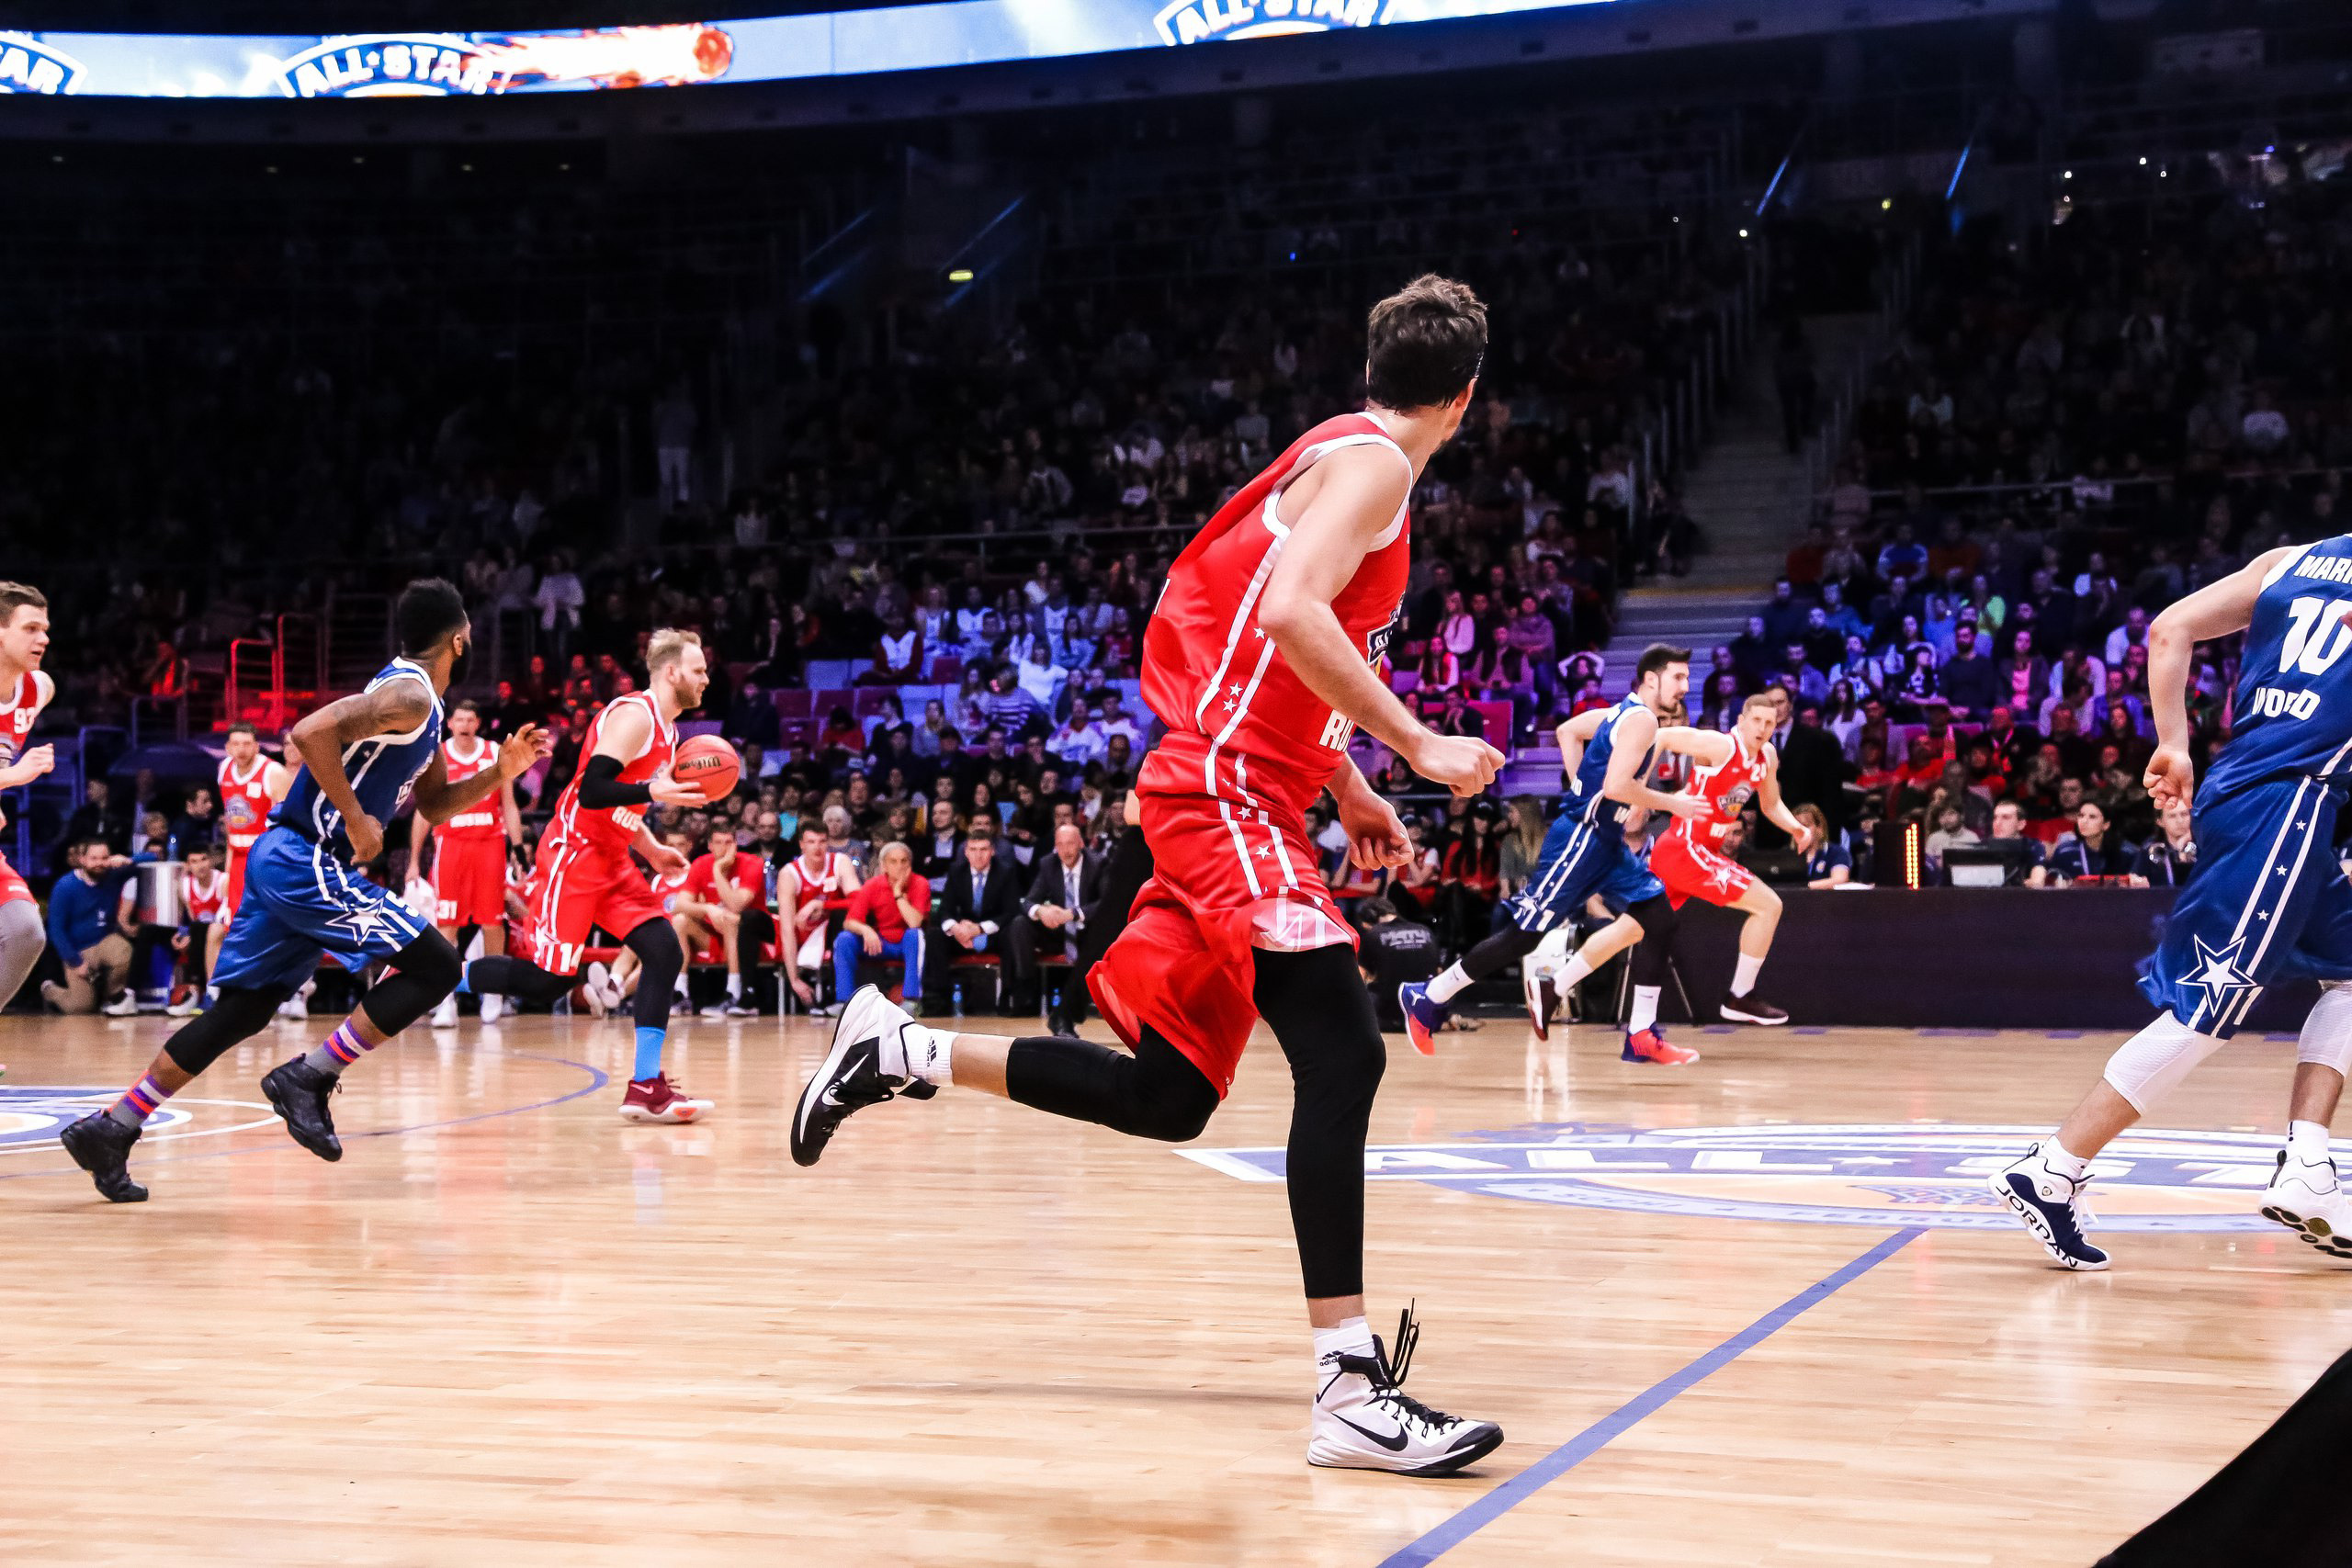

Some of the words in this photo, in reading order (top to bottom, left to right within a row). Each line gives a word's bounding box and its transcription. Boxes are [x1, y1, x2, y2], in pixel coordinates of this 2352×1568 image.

[0, 45, 65, 95] AR
[2278, 596, 2352, 676] 10
[1996, 1186, 2078, 1268] JORDAN
